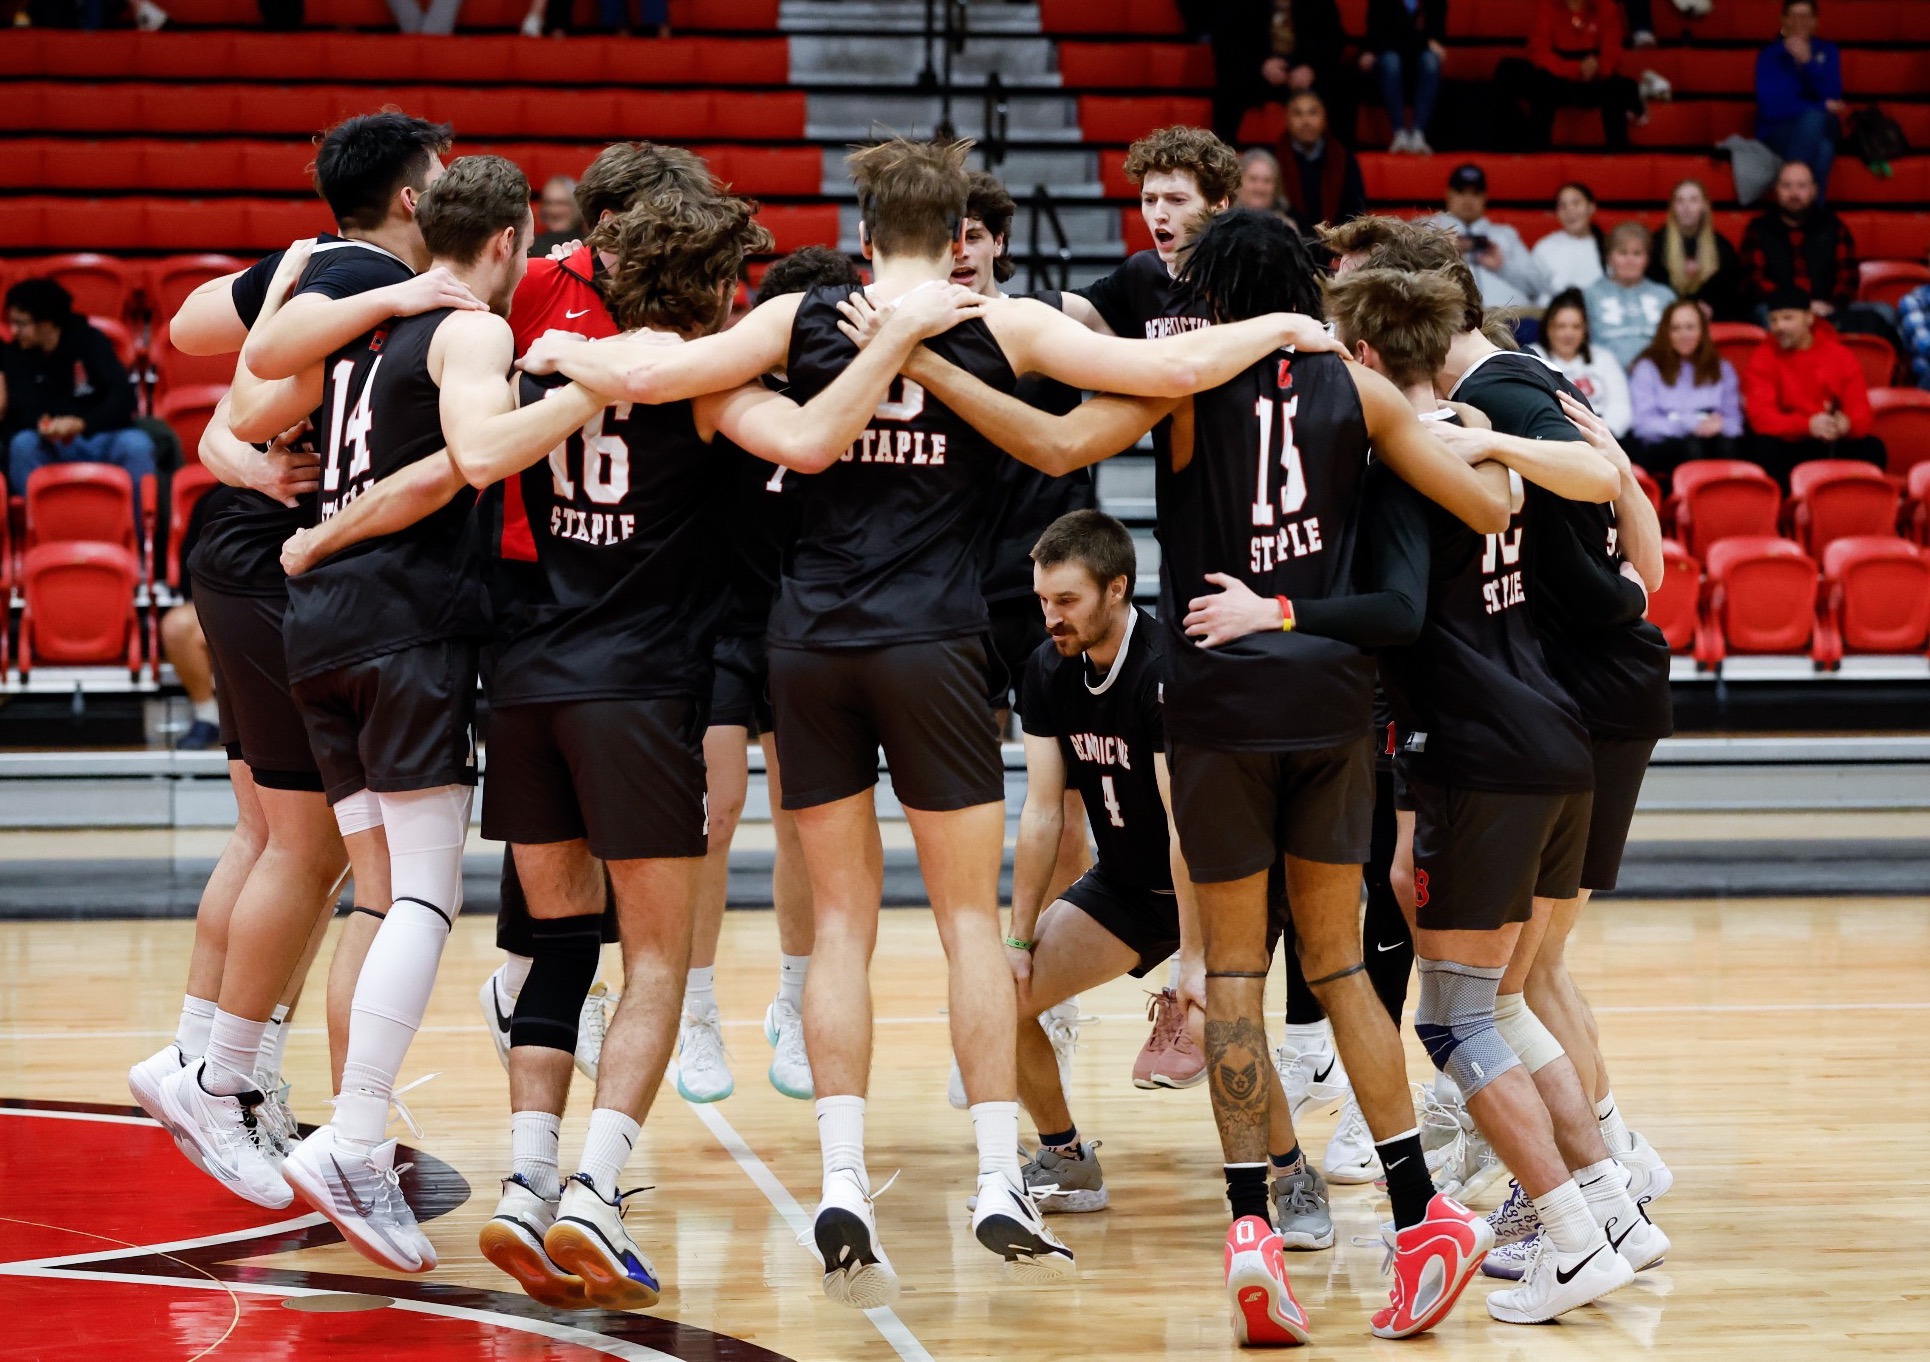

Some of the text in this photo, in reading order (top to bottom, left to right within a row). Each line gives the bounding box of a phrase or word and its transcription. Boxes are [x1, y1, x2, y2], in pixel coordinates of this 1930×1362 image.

[323, 353, 384, 491] 14
[550, 505, 635, 546] STAPLE
[1101, 775, 1125, 827] 4
